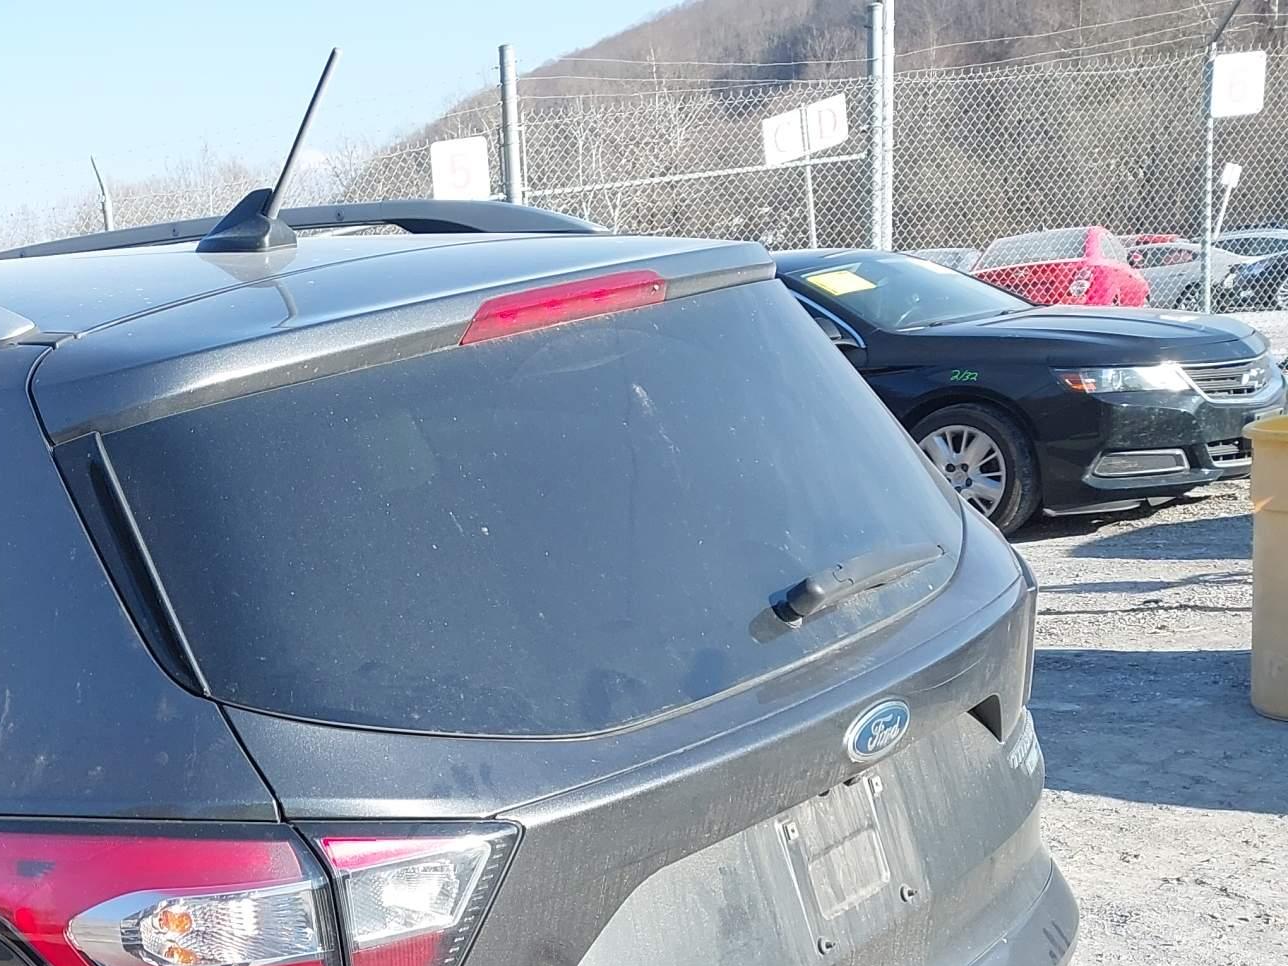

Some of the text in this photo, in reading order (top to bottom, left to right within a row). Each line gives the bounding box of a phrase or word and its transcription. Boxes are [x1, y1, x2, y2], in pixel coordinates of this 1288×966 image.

[817, 108, 838, 140] D
[449, 153, 472, 191] 5
[867, 713, 901, 752] Ford
